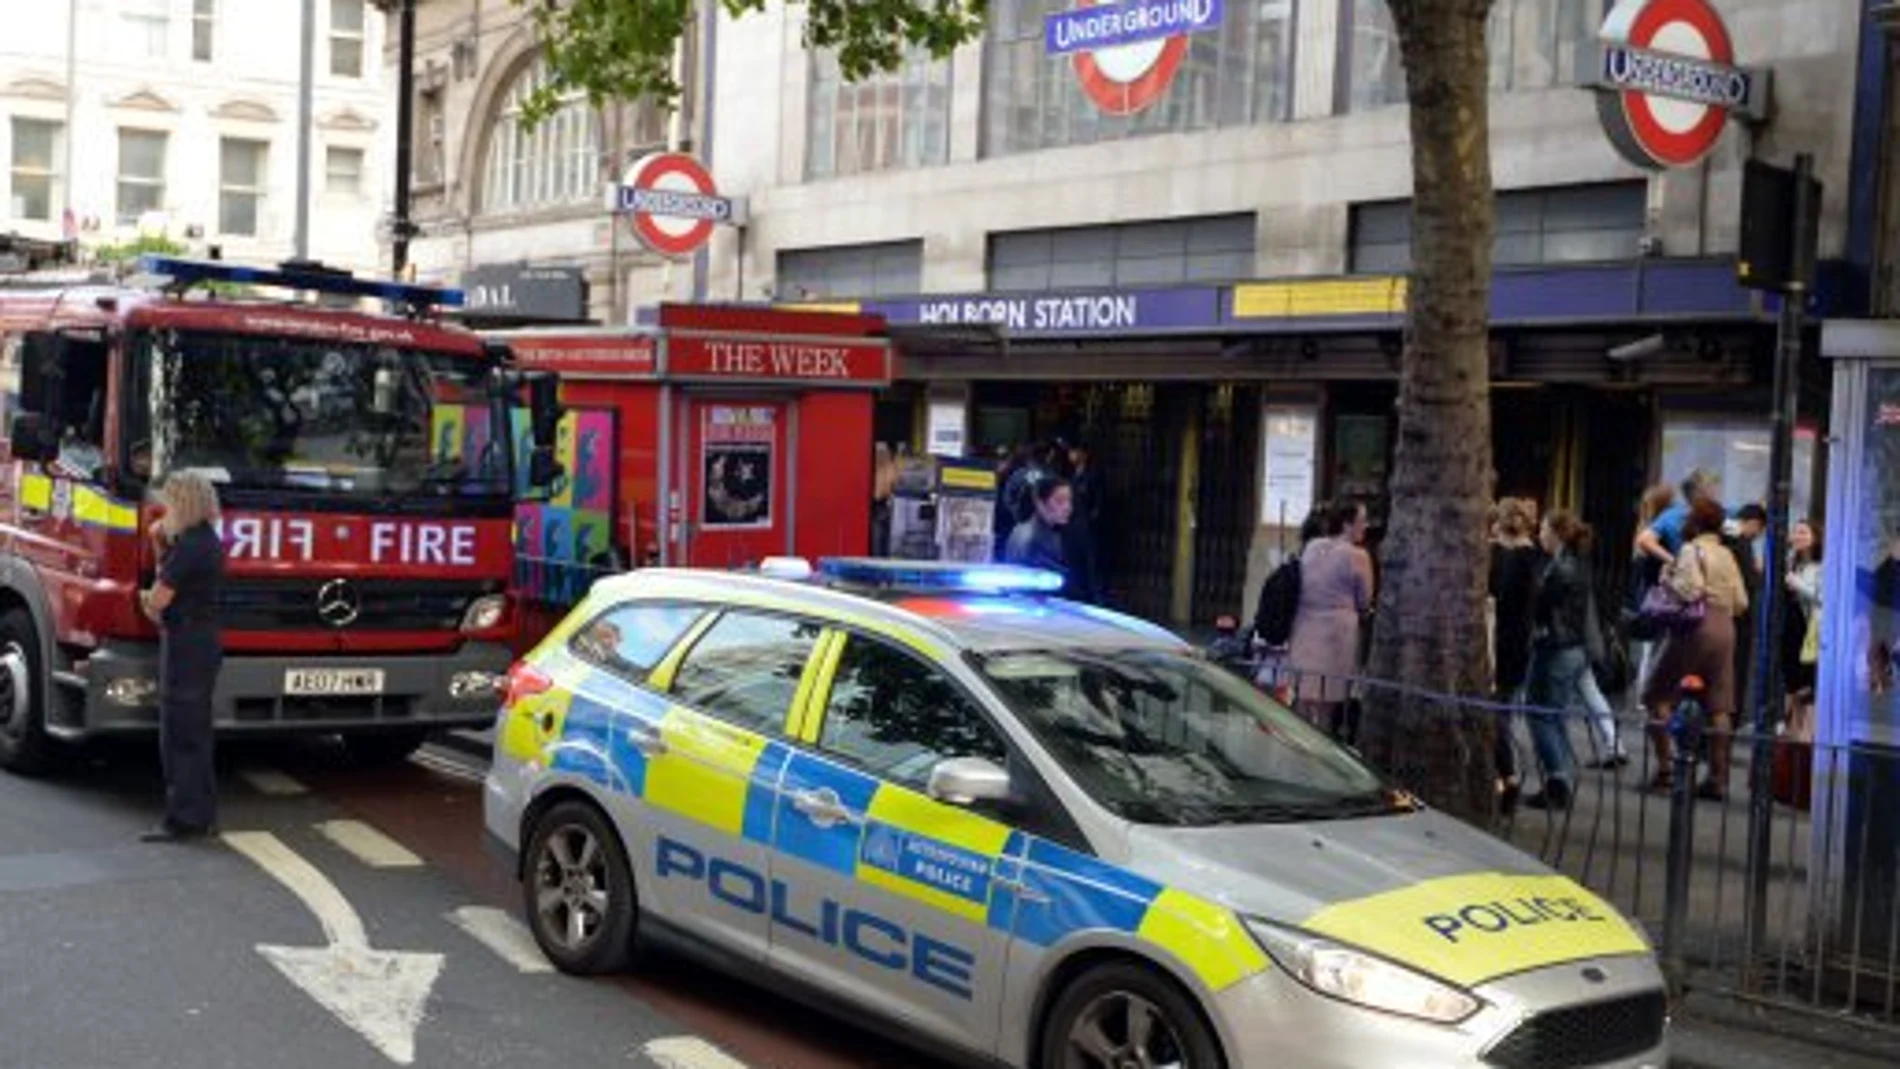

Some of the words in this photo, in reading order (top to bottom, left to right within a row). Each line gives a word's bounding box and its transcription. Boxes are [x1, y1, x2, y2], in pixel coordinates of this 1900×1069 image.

[1056, 0, 1213, 48] UNDERGROUND
[919, 299, 1026, 328] HOLBORN
[1034, 294, 1138, 328] STATION
[704, 341, 765, 373] THE
[769, 344, 851, 377] WEEK
[370, 522, 476, 565] FIRE
[655, 833, 975, 1002] POLICE
[1423, 896, 1608, 944] POLICE
